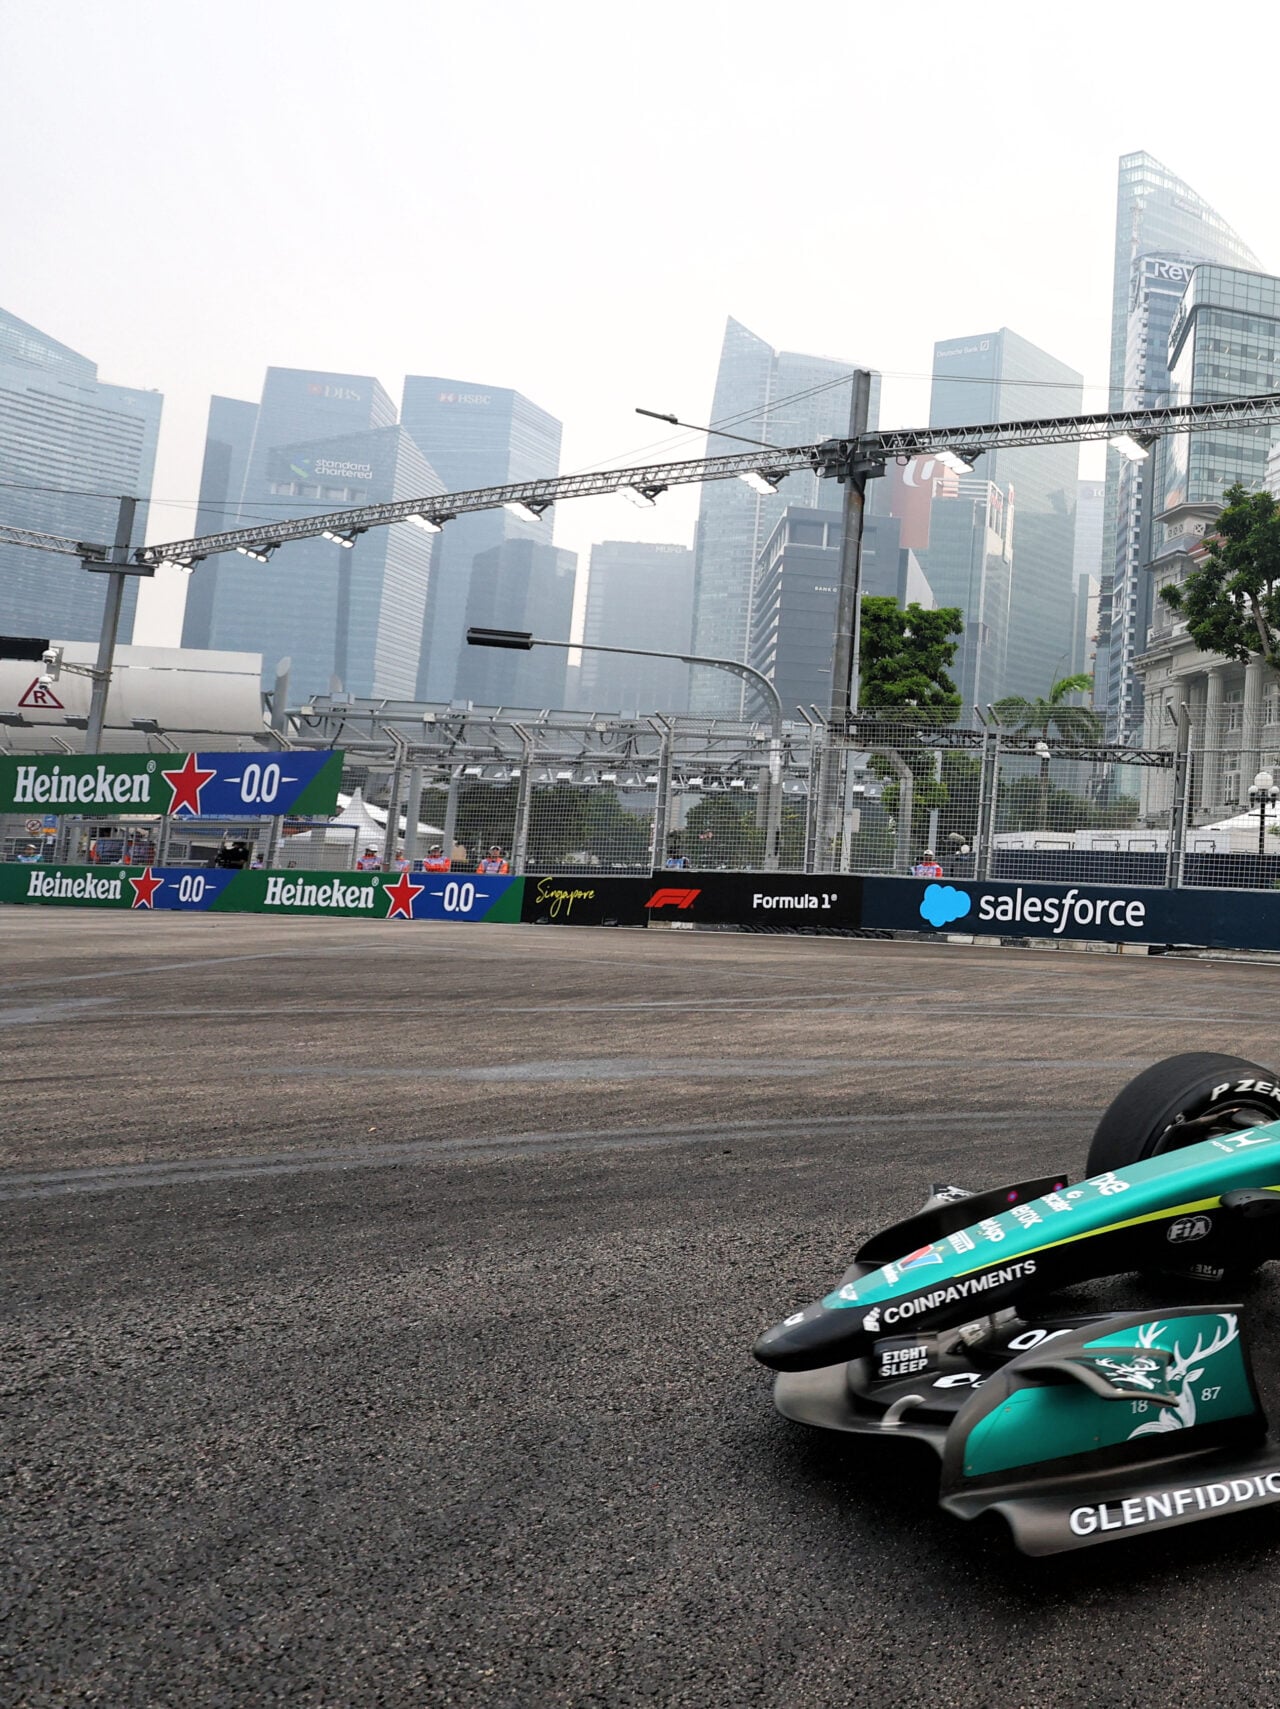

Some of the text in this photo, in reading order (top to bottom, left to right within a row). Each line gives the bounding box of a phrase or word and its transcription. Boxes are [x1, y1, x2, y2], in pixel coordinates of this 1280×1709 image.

[325, 384, 361, 401] DBS
[457, 393, 491, 405] HSBC
[314, 467, 373, 480] chartered
[315, 458, 370, 472] standard
[814, 585, 832, 593] BANK
[240, 763, 281, 803] 0.0
[179, 875, 204, 902] 0.0
[443, 882, 473, 912] 0.0
[537, 876, 596, 919] Singapore
[752, 894, 817, 909] Formula
[978, 888, 1146, 933] salesforce
[1209, 1082, 1231, 1102] P
[883, 1260, 1037, 1324] COINPAYMENTS
[882, 1346, 929, 1365] EIGHT
[881, 1358, 929, 1377] SLEEP
[1130, 1386, 1222, 1414] 18 87
